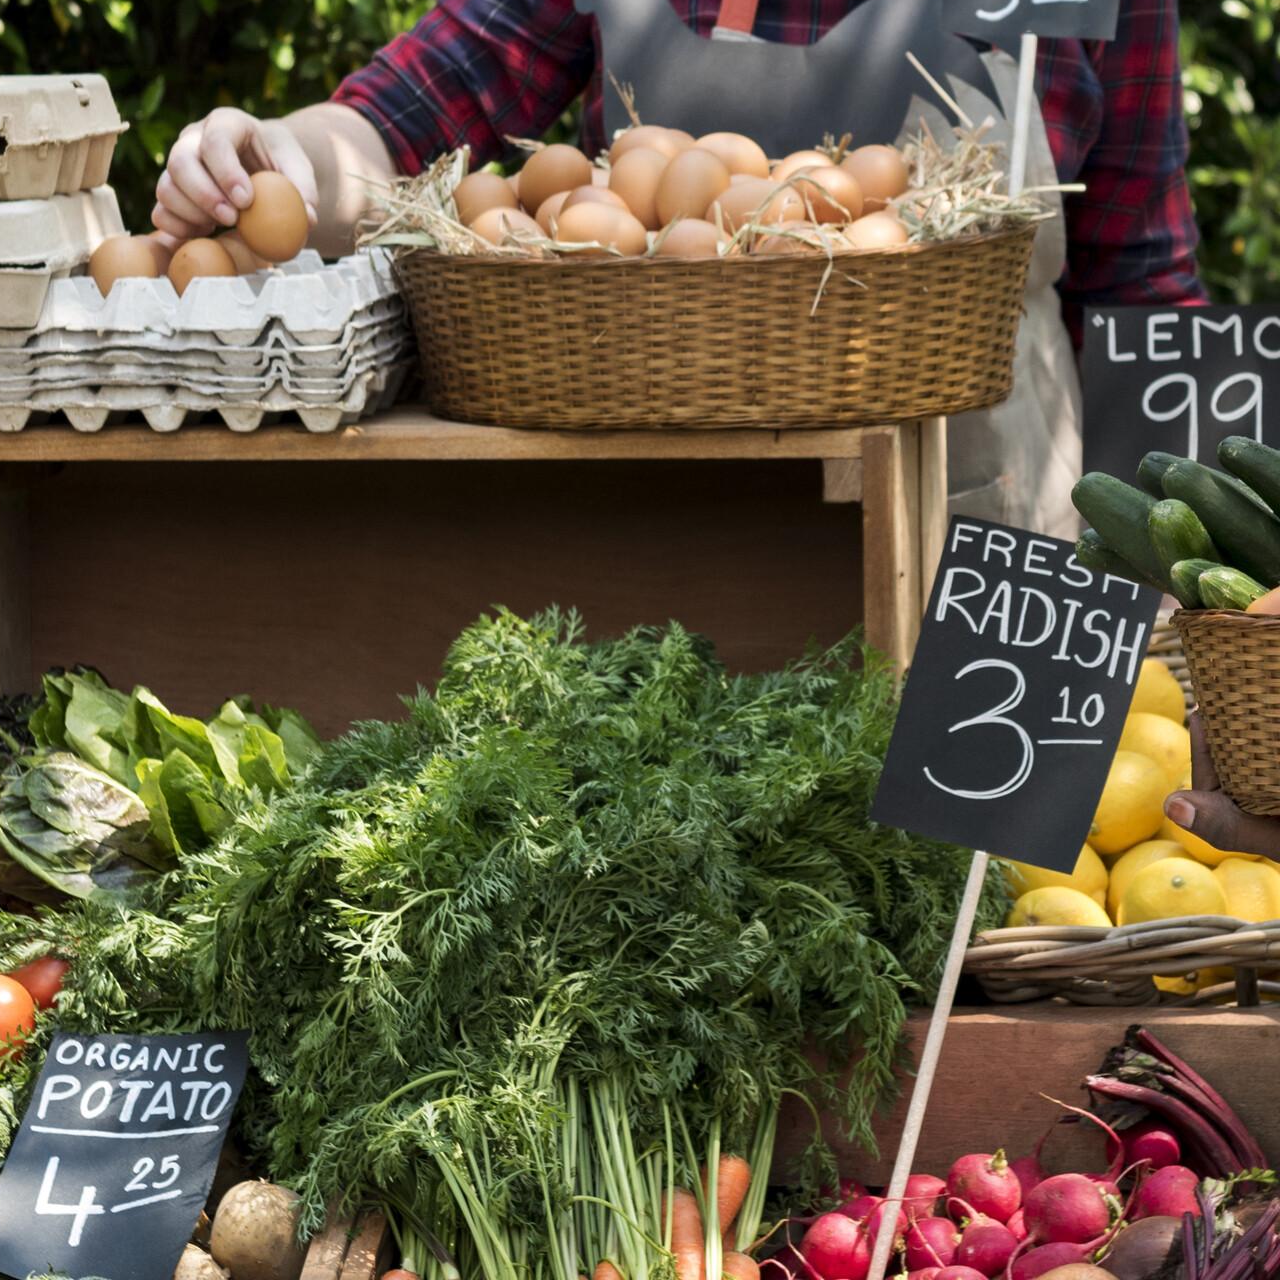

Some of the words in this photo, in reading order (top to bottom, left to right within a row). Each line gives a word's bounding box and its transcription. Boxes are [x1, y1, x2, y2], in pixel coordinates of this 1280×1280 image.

[1142, 372, 1263, 462] 99
[935, 567, 1147, 686] RADISH
[923, 658, 1035, 800] 3
[1051, 685, 1106, 728] 10
[36, 1074, 233, 1123] POTATO
[56, 1039, 226, 1074] ORGANIC
[35, 1155, 107, 1247] 4
[124, 1154, 182, 1193] 25
